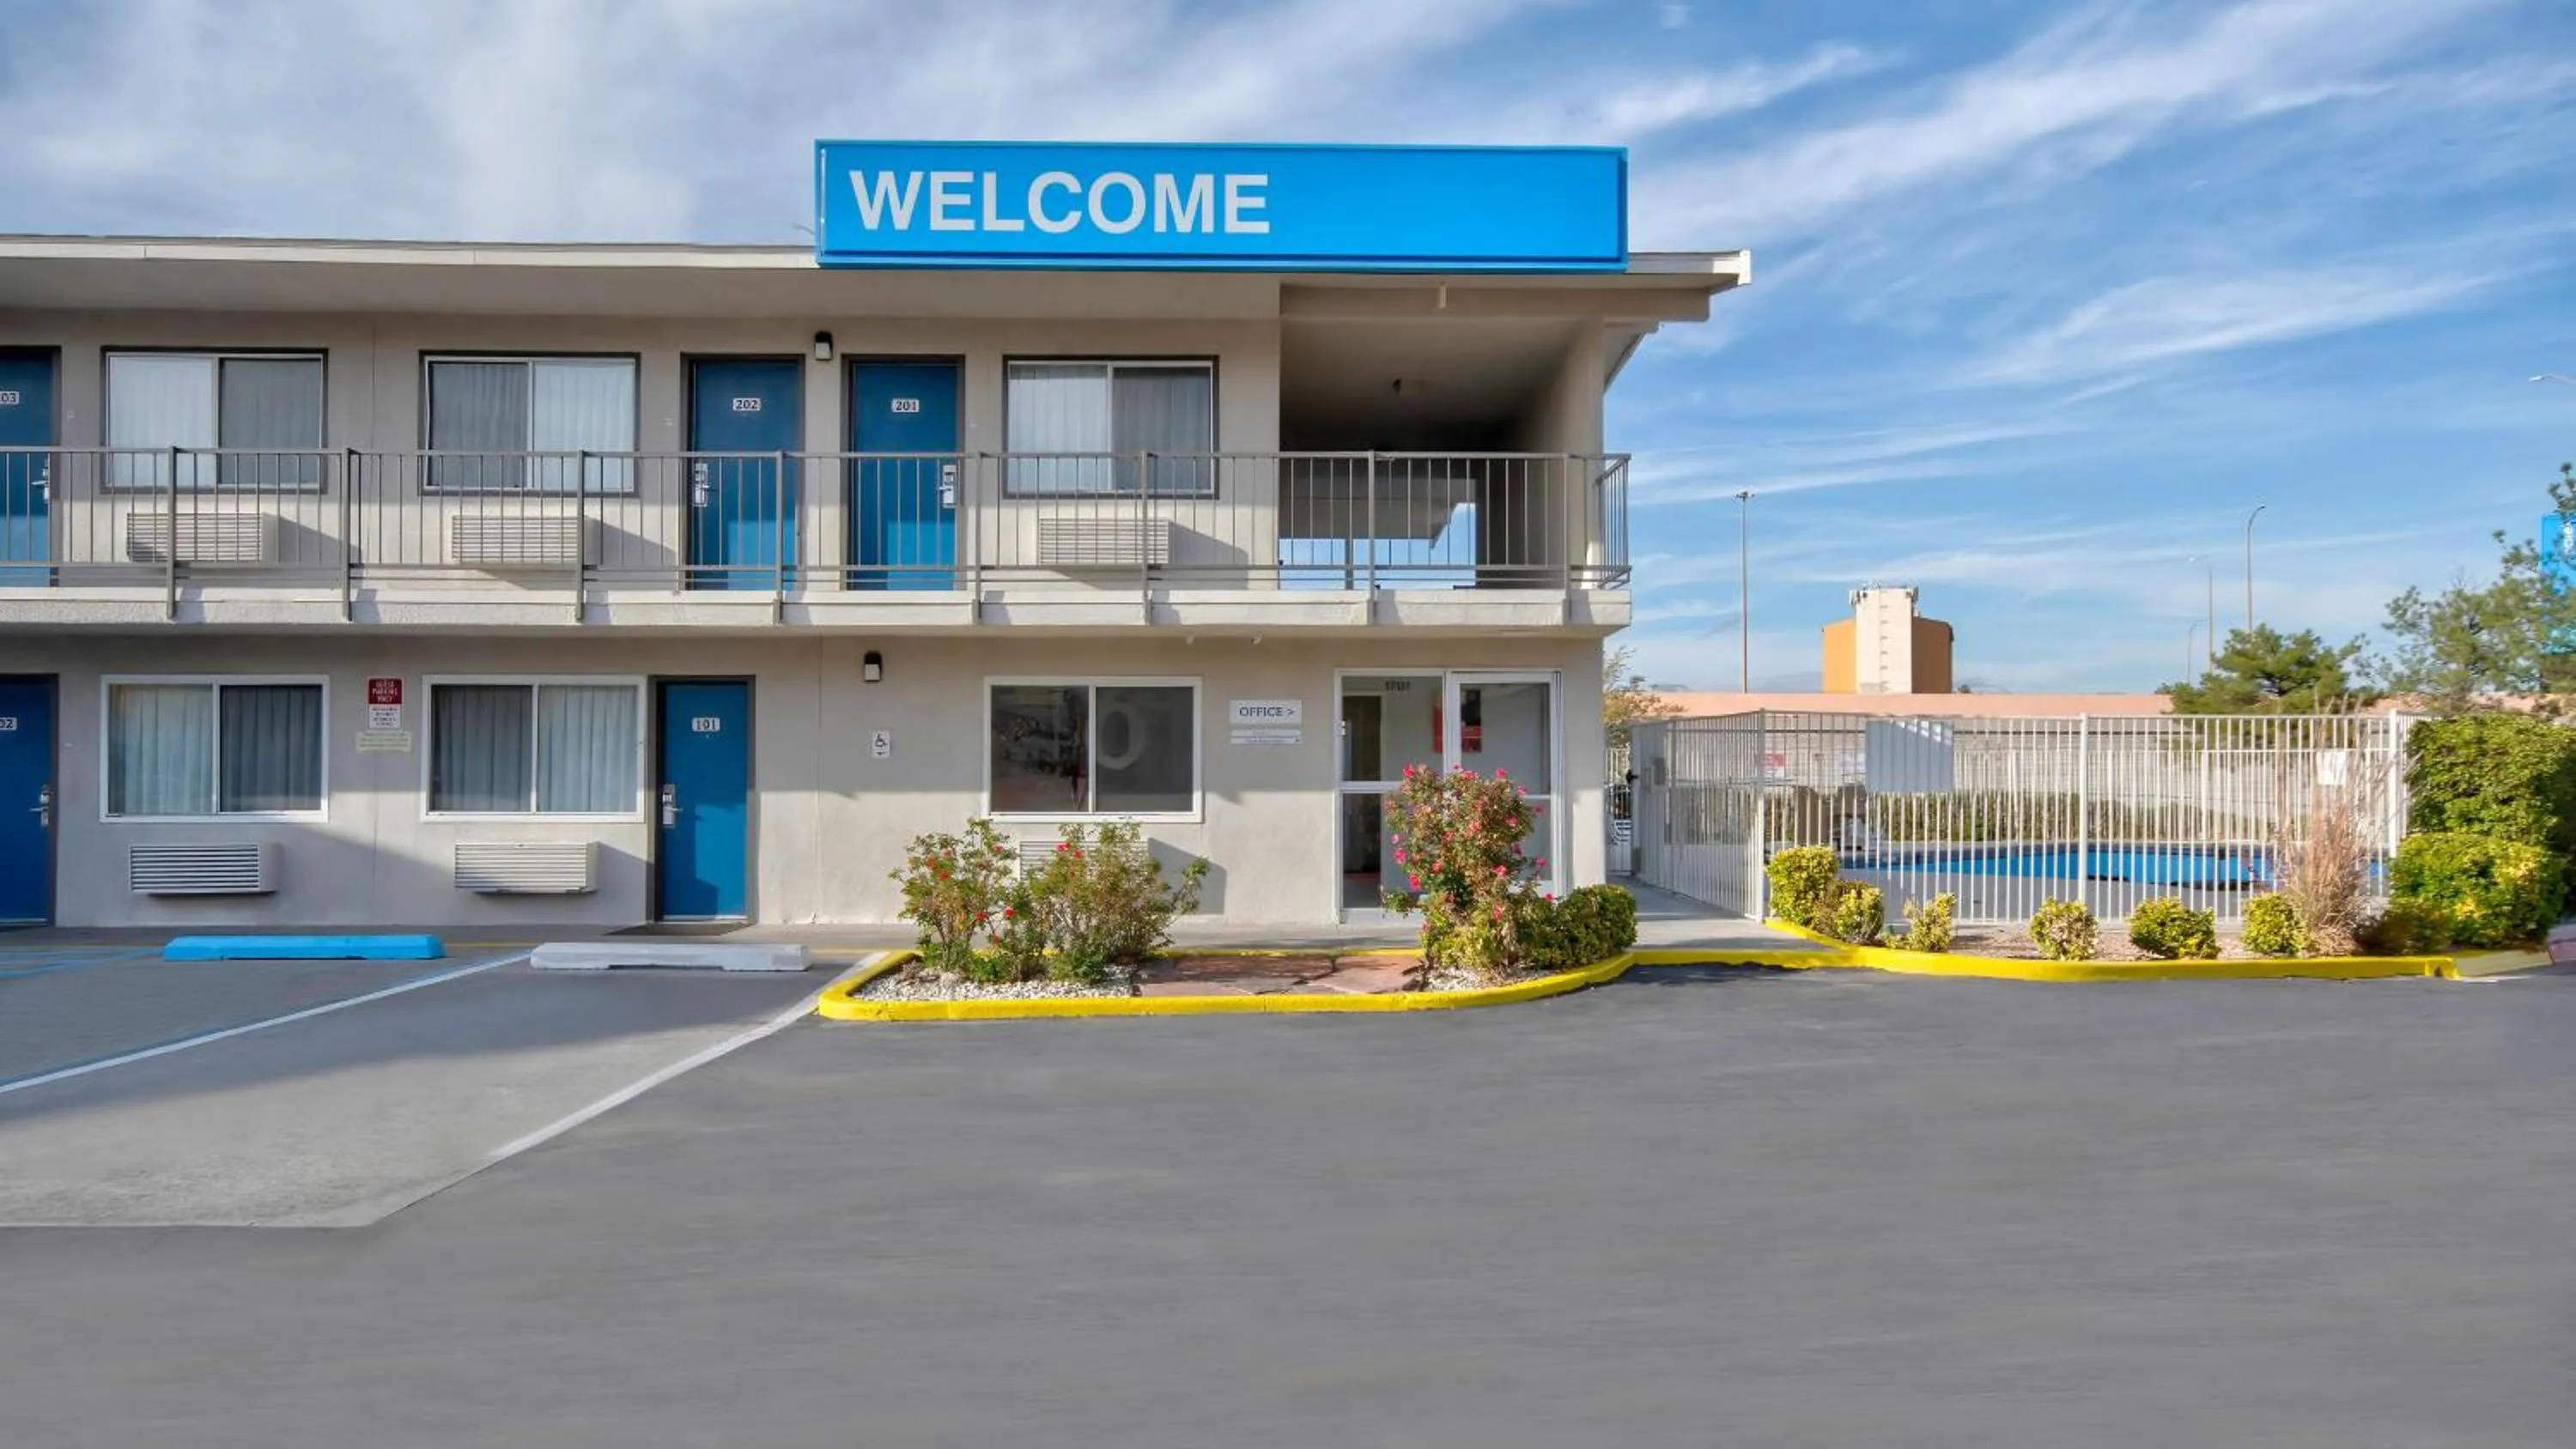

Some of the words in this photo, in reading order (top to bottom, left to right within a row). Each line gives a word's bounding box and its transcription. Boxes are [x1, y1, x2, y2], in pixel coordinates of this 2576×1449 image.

[849, 169, 1270, 234] WELCOME
[0, 392, 16, 403] 03
[735, 399, 758, 409] 202
[895, 400, 917, 411] 201
[1239, 706, 1284, 718] OFFICE
[0, 718, 15, 729] 02
[696, 719, 715, 731] 101
